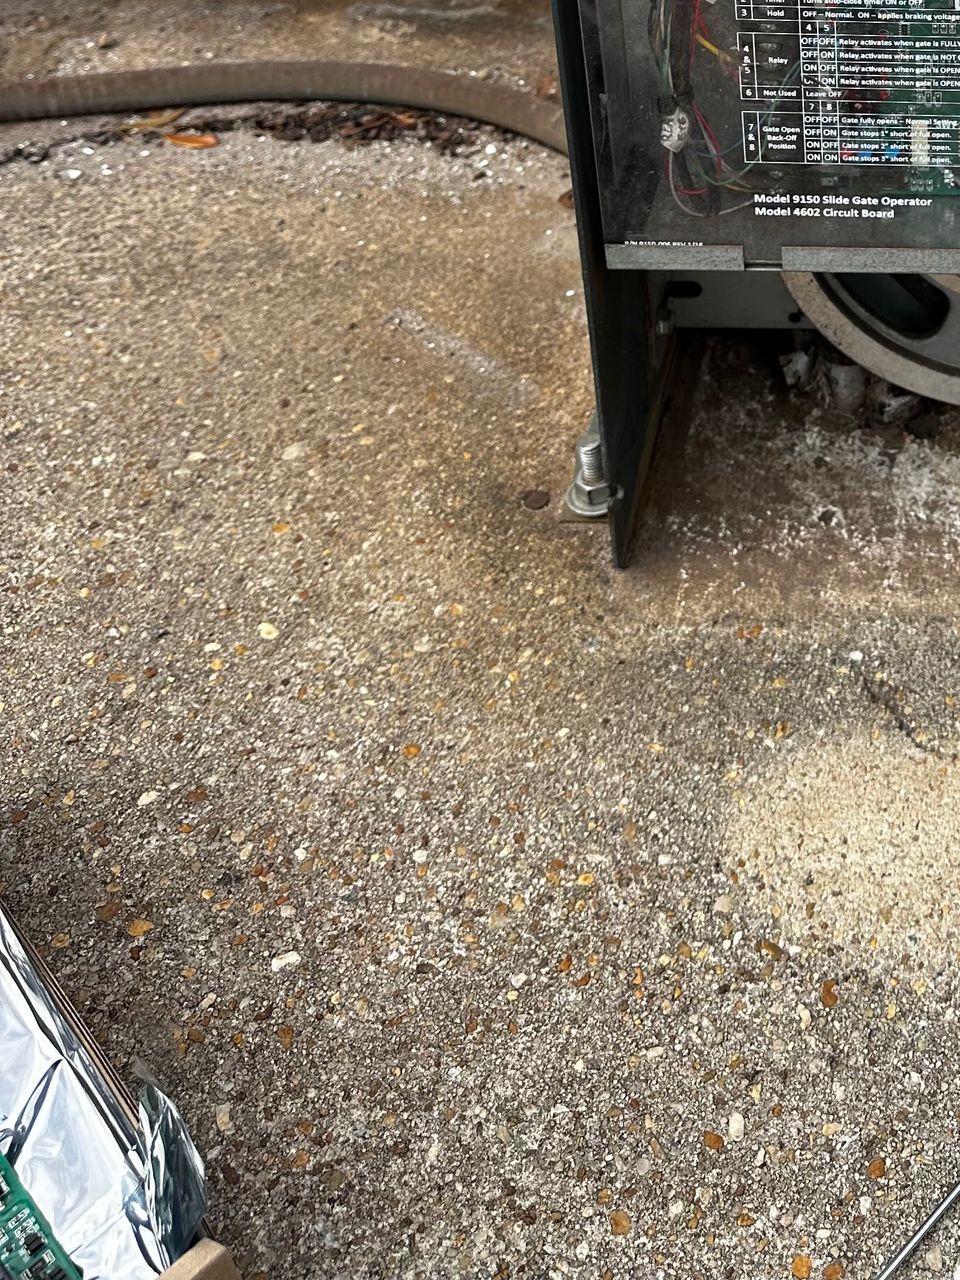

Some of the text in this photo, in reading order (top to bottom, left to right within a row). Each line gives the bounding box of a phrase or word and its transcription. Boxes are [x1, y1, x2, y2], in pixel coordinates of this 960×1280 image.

[754, 194, 932, 207] Model 9150 Slide Gate Operator
[755, 207, 894, 218] Model 4602 Circuit Board
